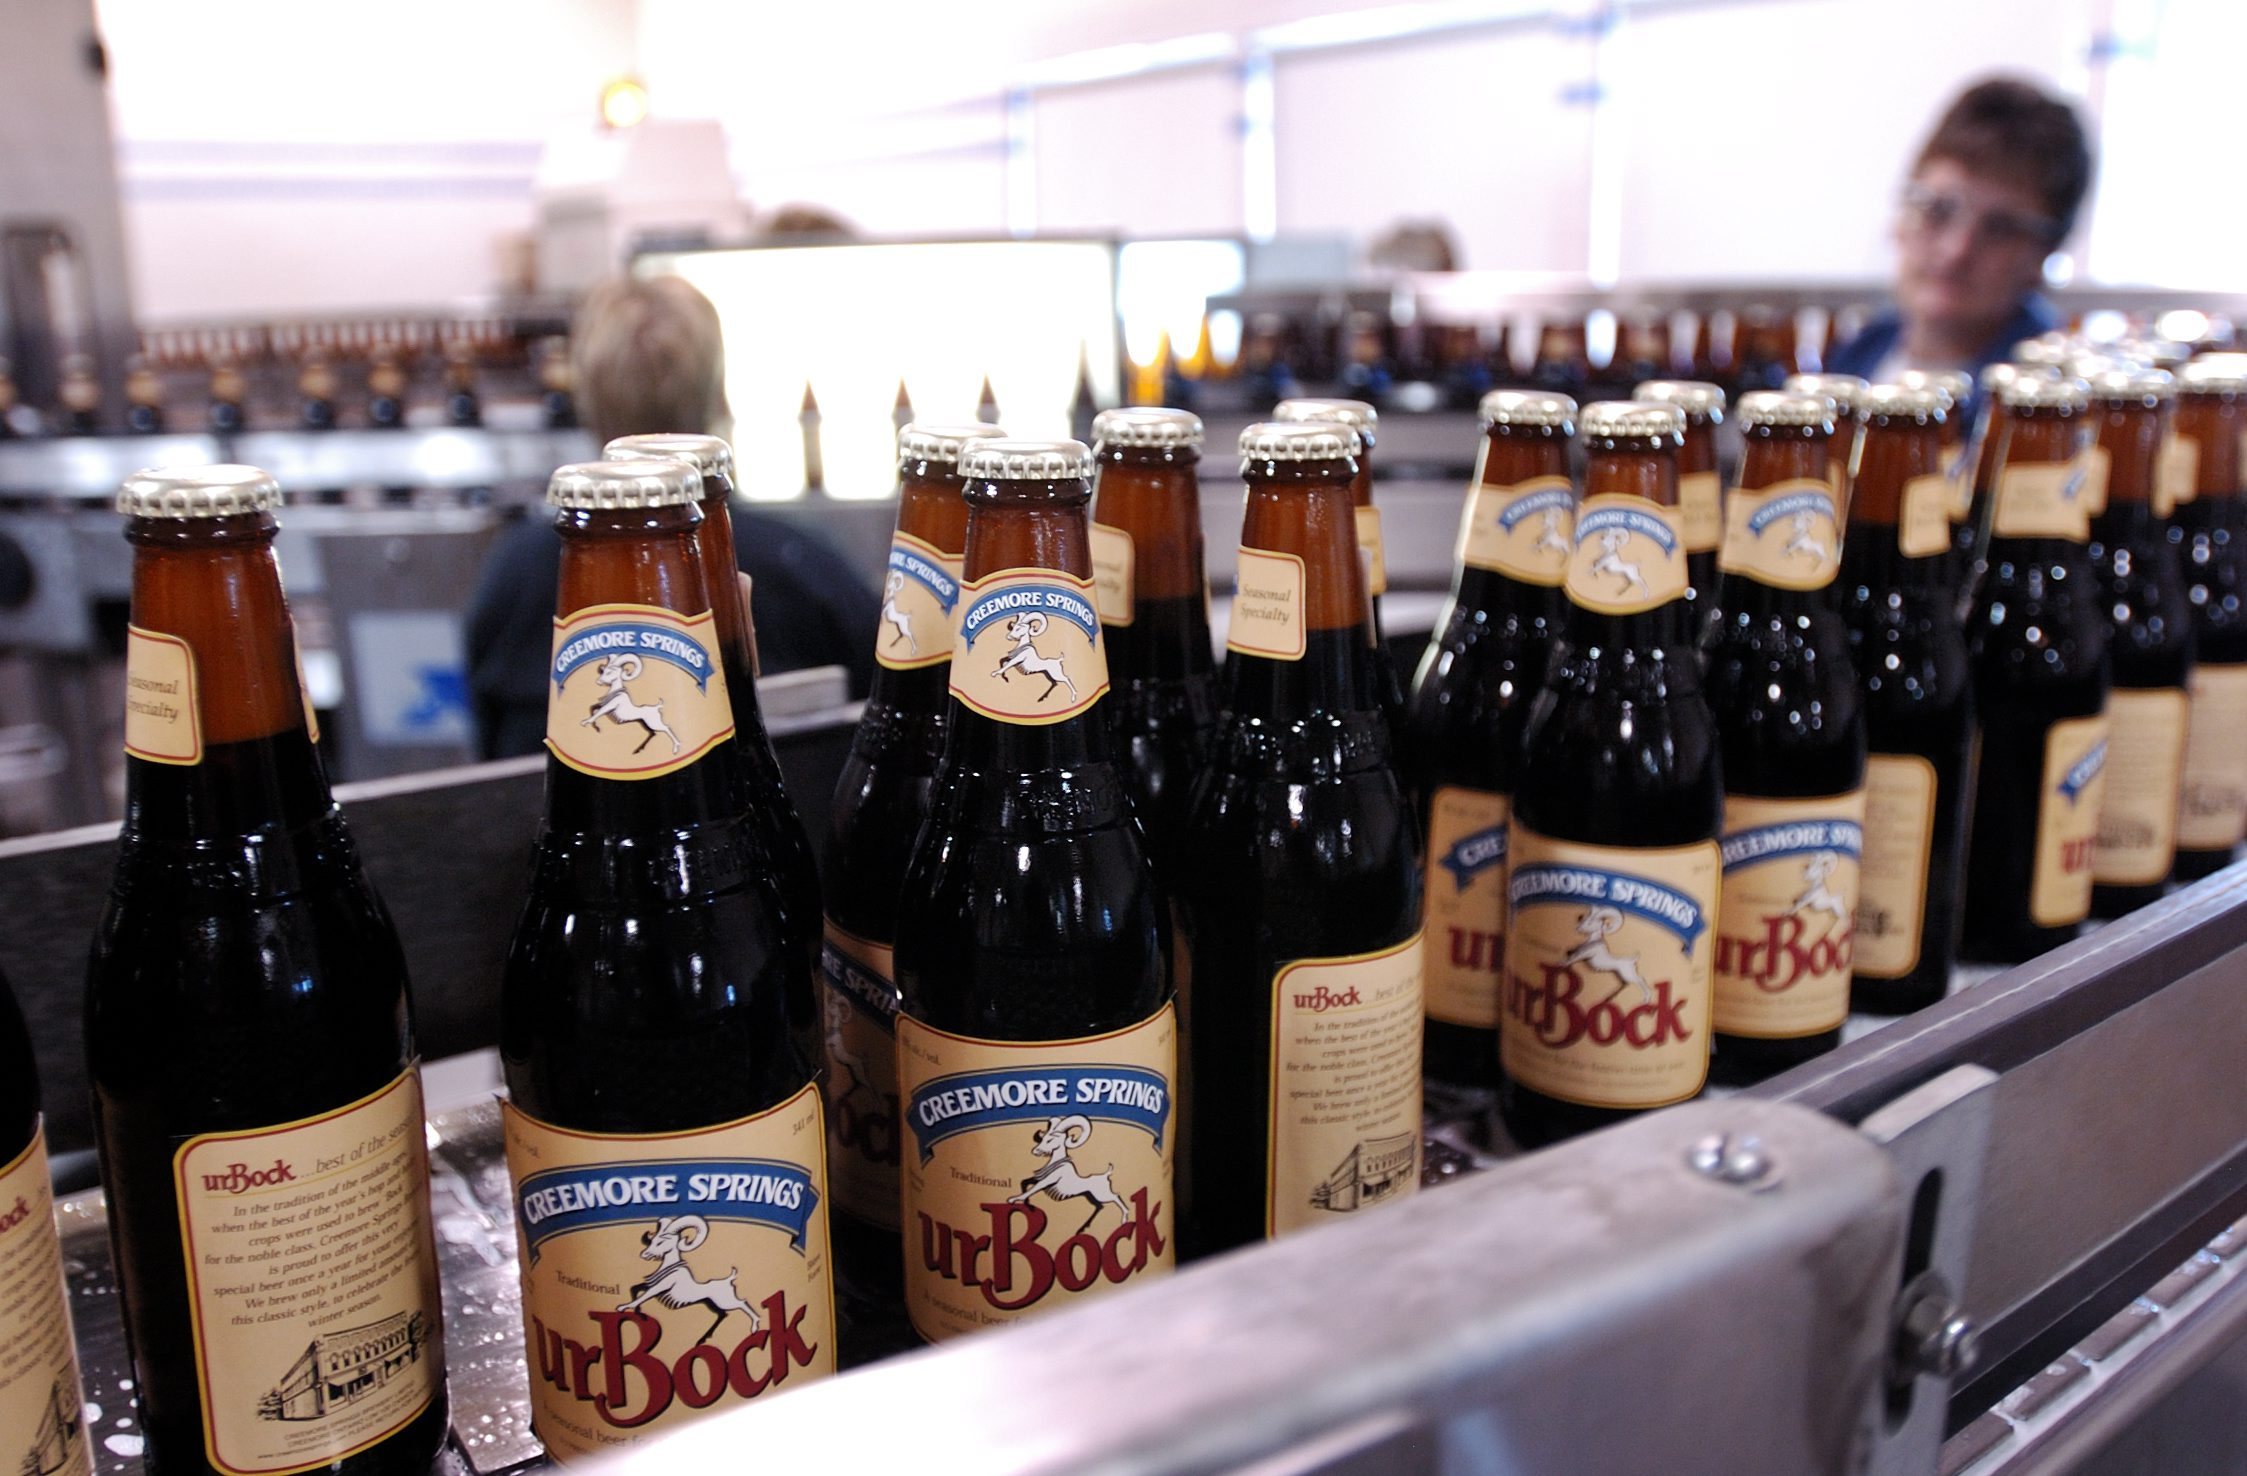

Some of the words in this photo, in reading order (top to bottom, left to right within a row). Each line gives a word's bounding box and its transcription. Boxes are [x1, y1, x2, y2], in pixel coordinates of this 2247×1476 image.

[905, 556, 954, 596] SPRINGS
[1243, 583, 1291, 603] Seasonal
[965, 591, 1042, 629] CREEMORE
[1045, 592, 1095, 626] SPRINGS
[1240, 602, 1290, 626] Specialty
[556, 631, 636, 673] CREEMORE
[640, 631, 704, 668] SPRINGS
[1610, 877, 1698, 929] SPRINGS
[1293, 985, 1362, 1013] urBock
[919, 1078, 1069, 1128] CREEMORE
[1075, 1078, 1164, 1115] SPRINGS
[201, 1158, 298, 1195] urBock
[350, 1141, 366, 1162] of
[367, 1134, 387, 1154] the
[949, 1166, 1013, 1189] Traditional
[233, 1206, 247, 1217] In
[250, 1203, 270, 1215] the
[273, 1191, 325, 1211] tradition
[328, 1183, 340, 1197] of
[342, 1178, 359, 1192] the
[524, 1175, 679, 1225] CREEMORE
[687, 1173, 805, 1211] SPRINGS
[211, 1222, 245, 1234] when
[248, 1219, 269, 1232] the
[271, 1213, 297, 1227] best
[298, 1207, 313, 1222] of
[314, 1204, 332, 1218] the
[248, 1234, 282, 1247] crops
[285, 1226, 314, 1241] were
[316, 1214, 342, 1233] used
[344, 1212, 356, 1223] to
[204, 1254, 221, 1265] for
[225, 1254, 245, 1265] the
[247, 1248, 282, 1263] noble
[320, 1221, 370, 1248] Creemore
[917, 1186, 1166, 1311] urBock
[213, 1282, 256, 1298] special
[258, 1280, 285, 1293] beer
[287, 1273, 316, 1288] once
[318, 1270, 326, 1279] a
[328, 1259, 353, 1280] year
[354, 1252, 370, 1265] for
[268, 1264, 281, 1276] is
[283, 1253, 319, 1276] proud
[320, 1252, 333, 1263] to
[555, 1269, 621, 1296] Traditional
[231, 1314, 254, 1326] this
[256, 1307, 297, 1323] classic
[333, 1294, 345, 1306] to
[244, 1297, 265, 1309] We
[268, 1293, 298, 1306] brew
[301, 1284, 328, 1300] only
[308, 1308, 345, 1328] winter
[531, 1289, 818, 1430] urBock
